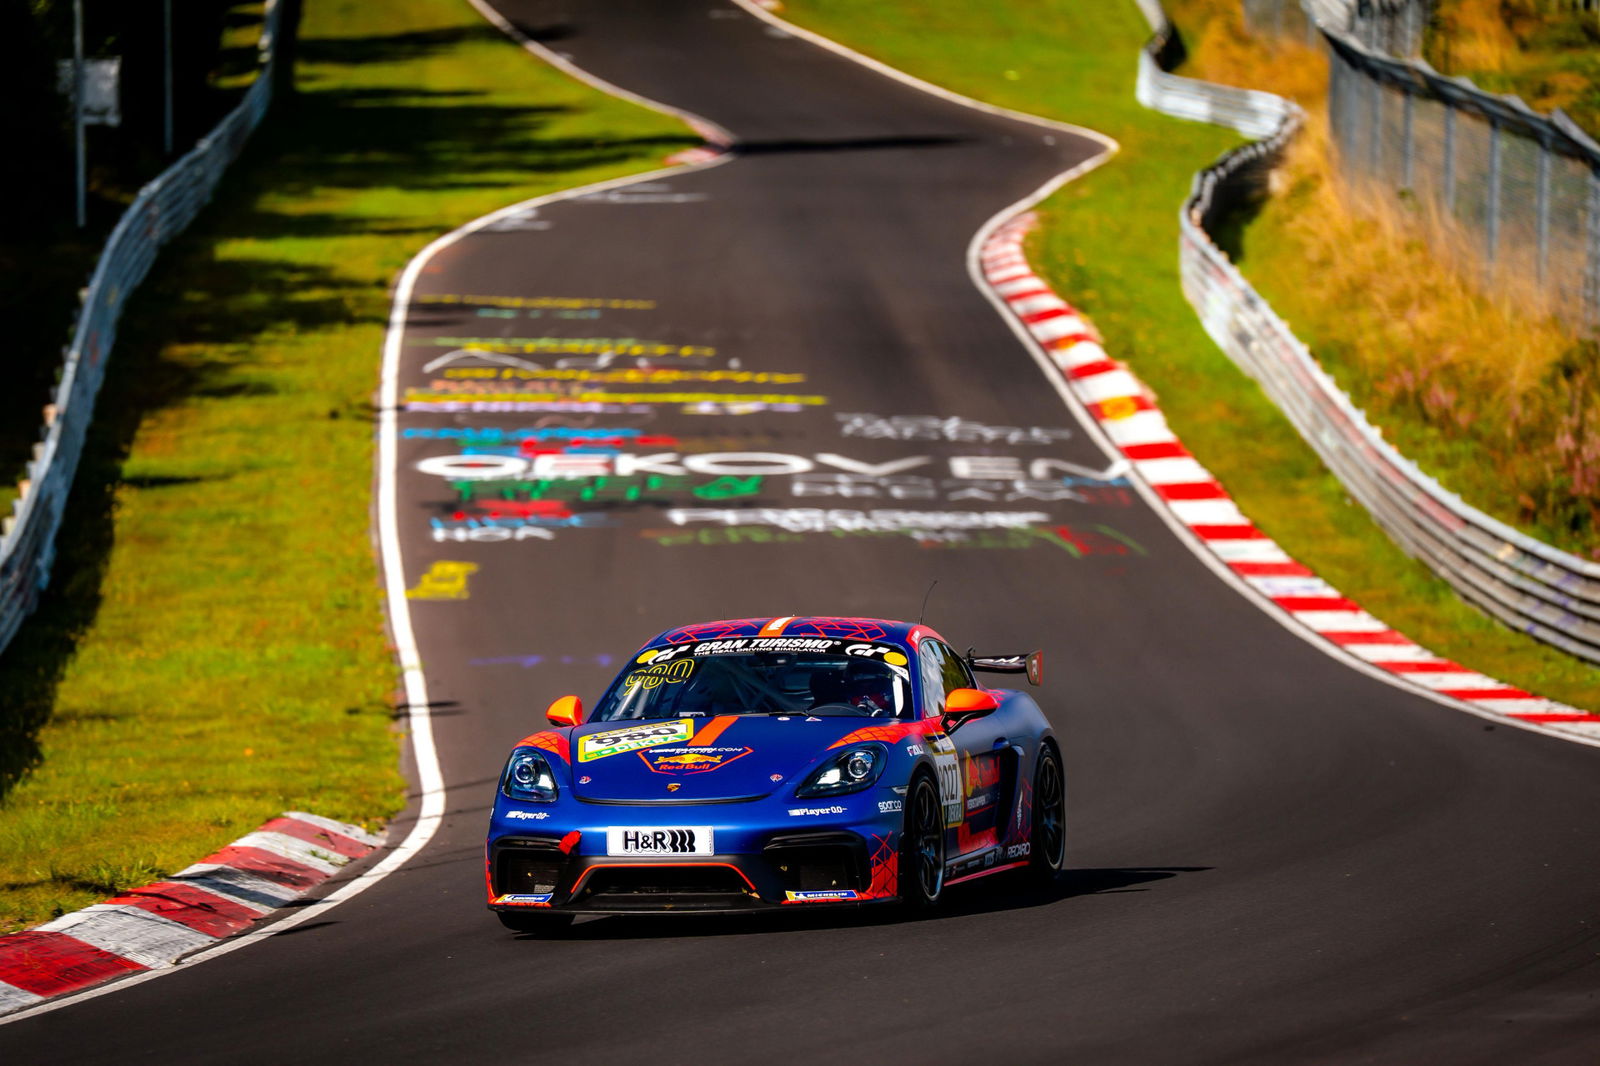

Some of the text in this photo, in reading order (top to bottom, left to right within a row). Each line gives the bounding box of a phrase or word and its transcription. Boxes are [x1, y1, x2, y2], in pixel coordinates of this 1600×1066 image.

[416, 452, 1132, 481] OEKOVEN
[694, 639, 748, 653] GRAN
[623, 658, 695, 697] 980
[595, 728, 679, 747] 980
[615, 734, 682, 752] DEKRA
[659, 762, 711, 771] Red Bull
[800, 806, 843, 816] Player 0.0
[878, 799, 902, 812] sparco
[623, 830, 669, 853] H&R
[1007, 842, 1031, 859] RECARO
